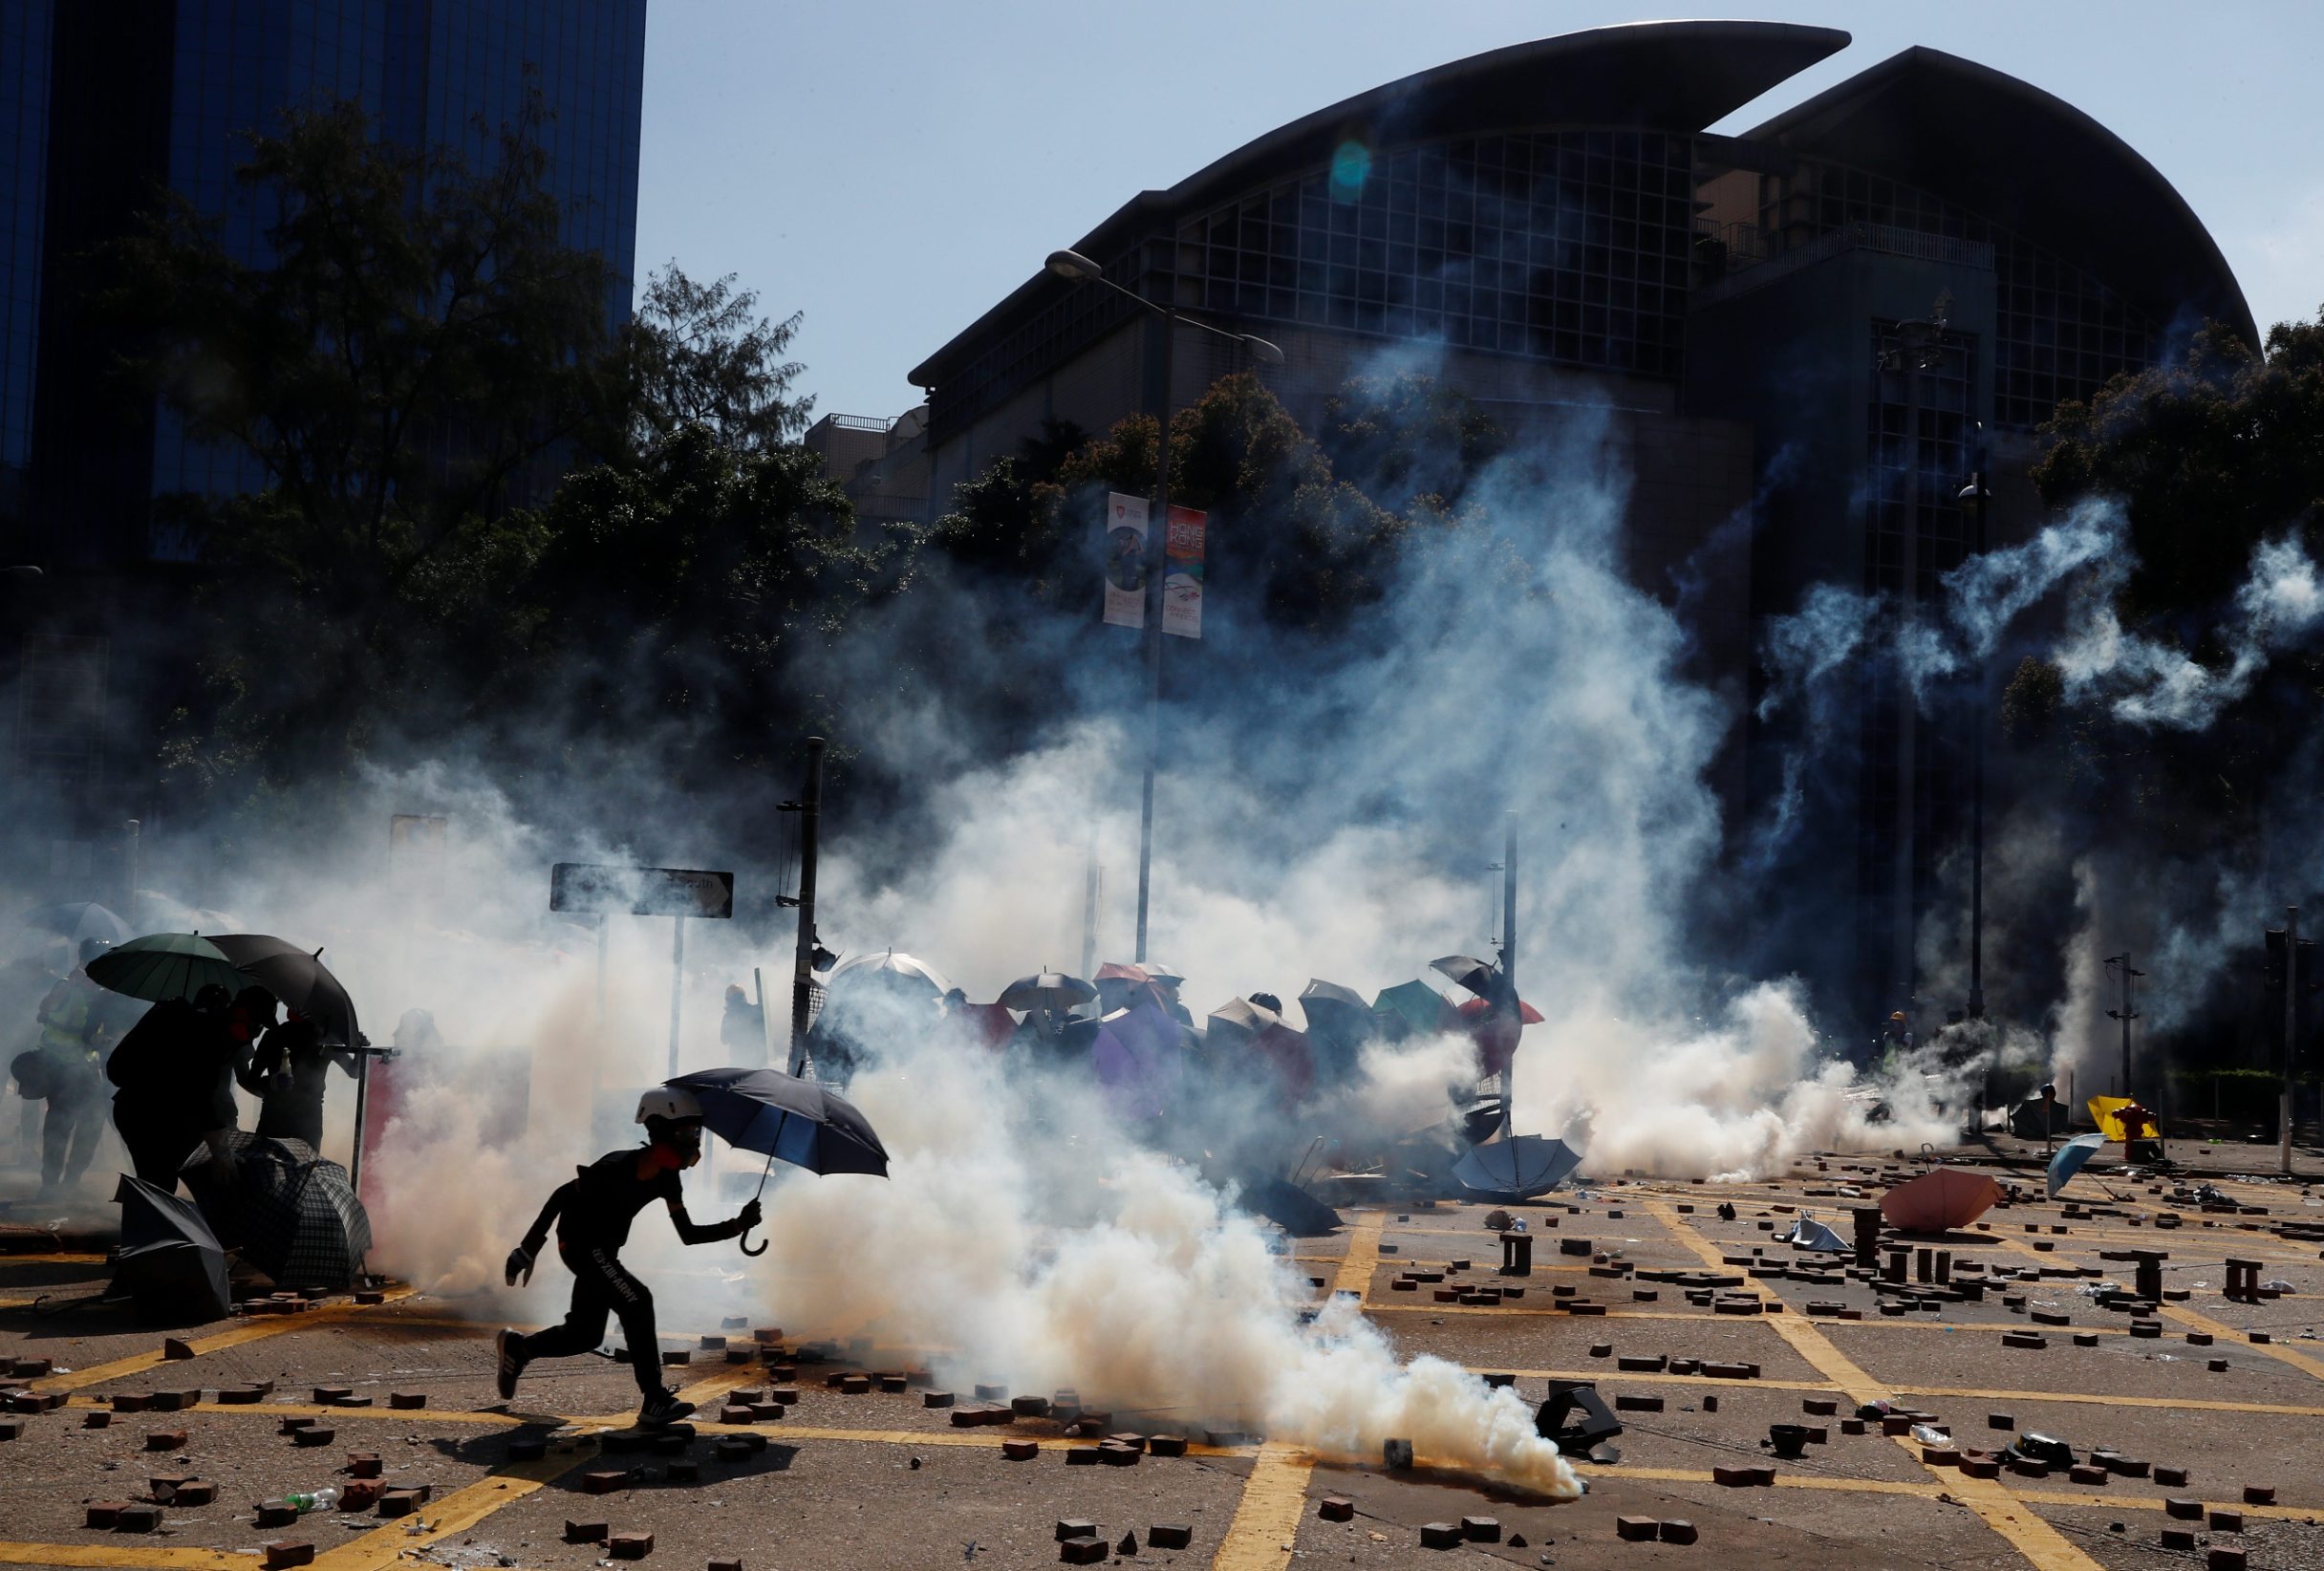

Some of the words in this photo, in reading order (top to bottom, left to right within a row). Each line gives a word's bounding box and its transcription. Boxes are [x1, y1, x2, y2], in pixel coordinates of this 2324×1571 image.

[1170, 522, 1203, 537] HONG
[1170, 532, 1203, 549] KONG
[678, 876, 713, 888] South
